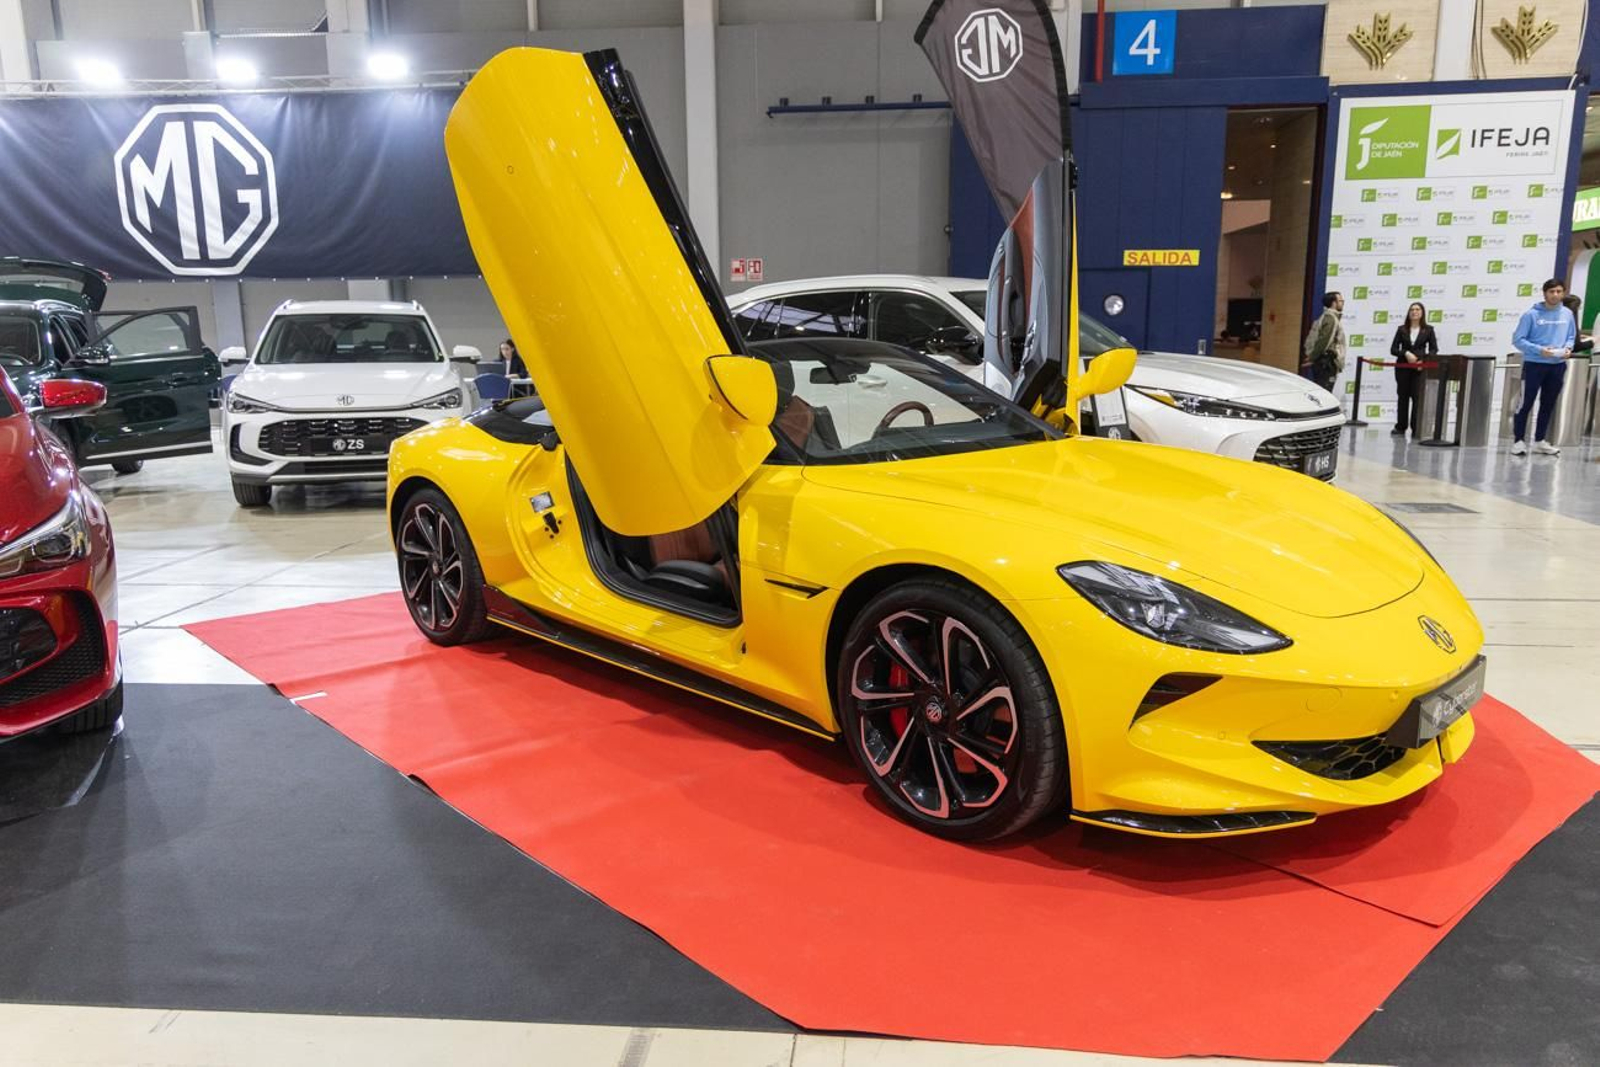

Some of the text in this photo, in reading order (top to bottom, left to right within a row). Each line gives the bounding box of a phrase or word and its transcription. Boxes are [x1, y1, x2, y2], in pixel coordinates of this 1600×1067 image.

[1129, 19, 1161, 66] 4
[1471, 126, 1550, 148] IFEJA
[129, 120, 263, 260] MG
[1127, 251, 1193, 265] SALIDA
[347, 438, 365, 450] ZS
